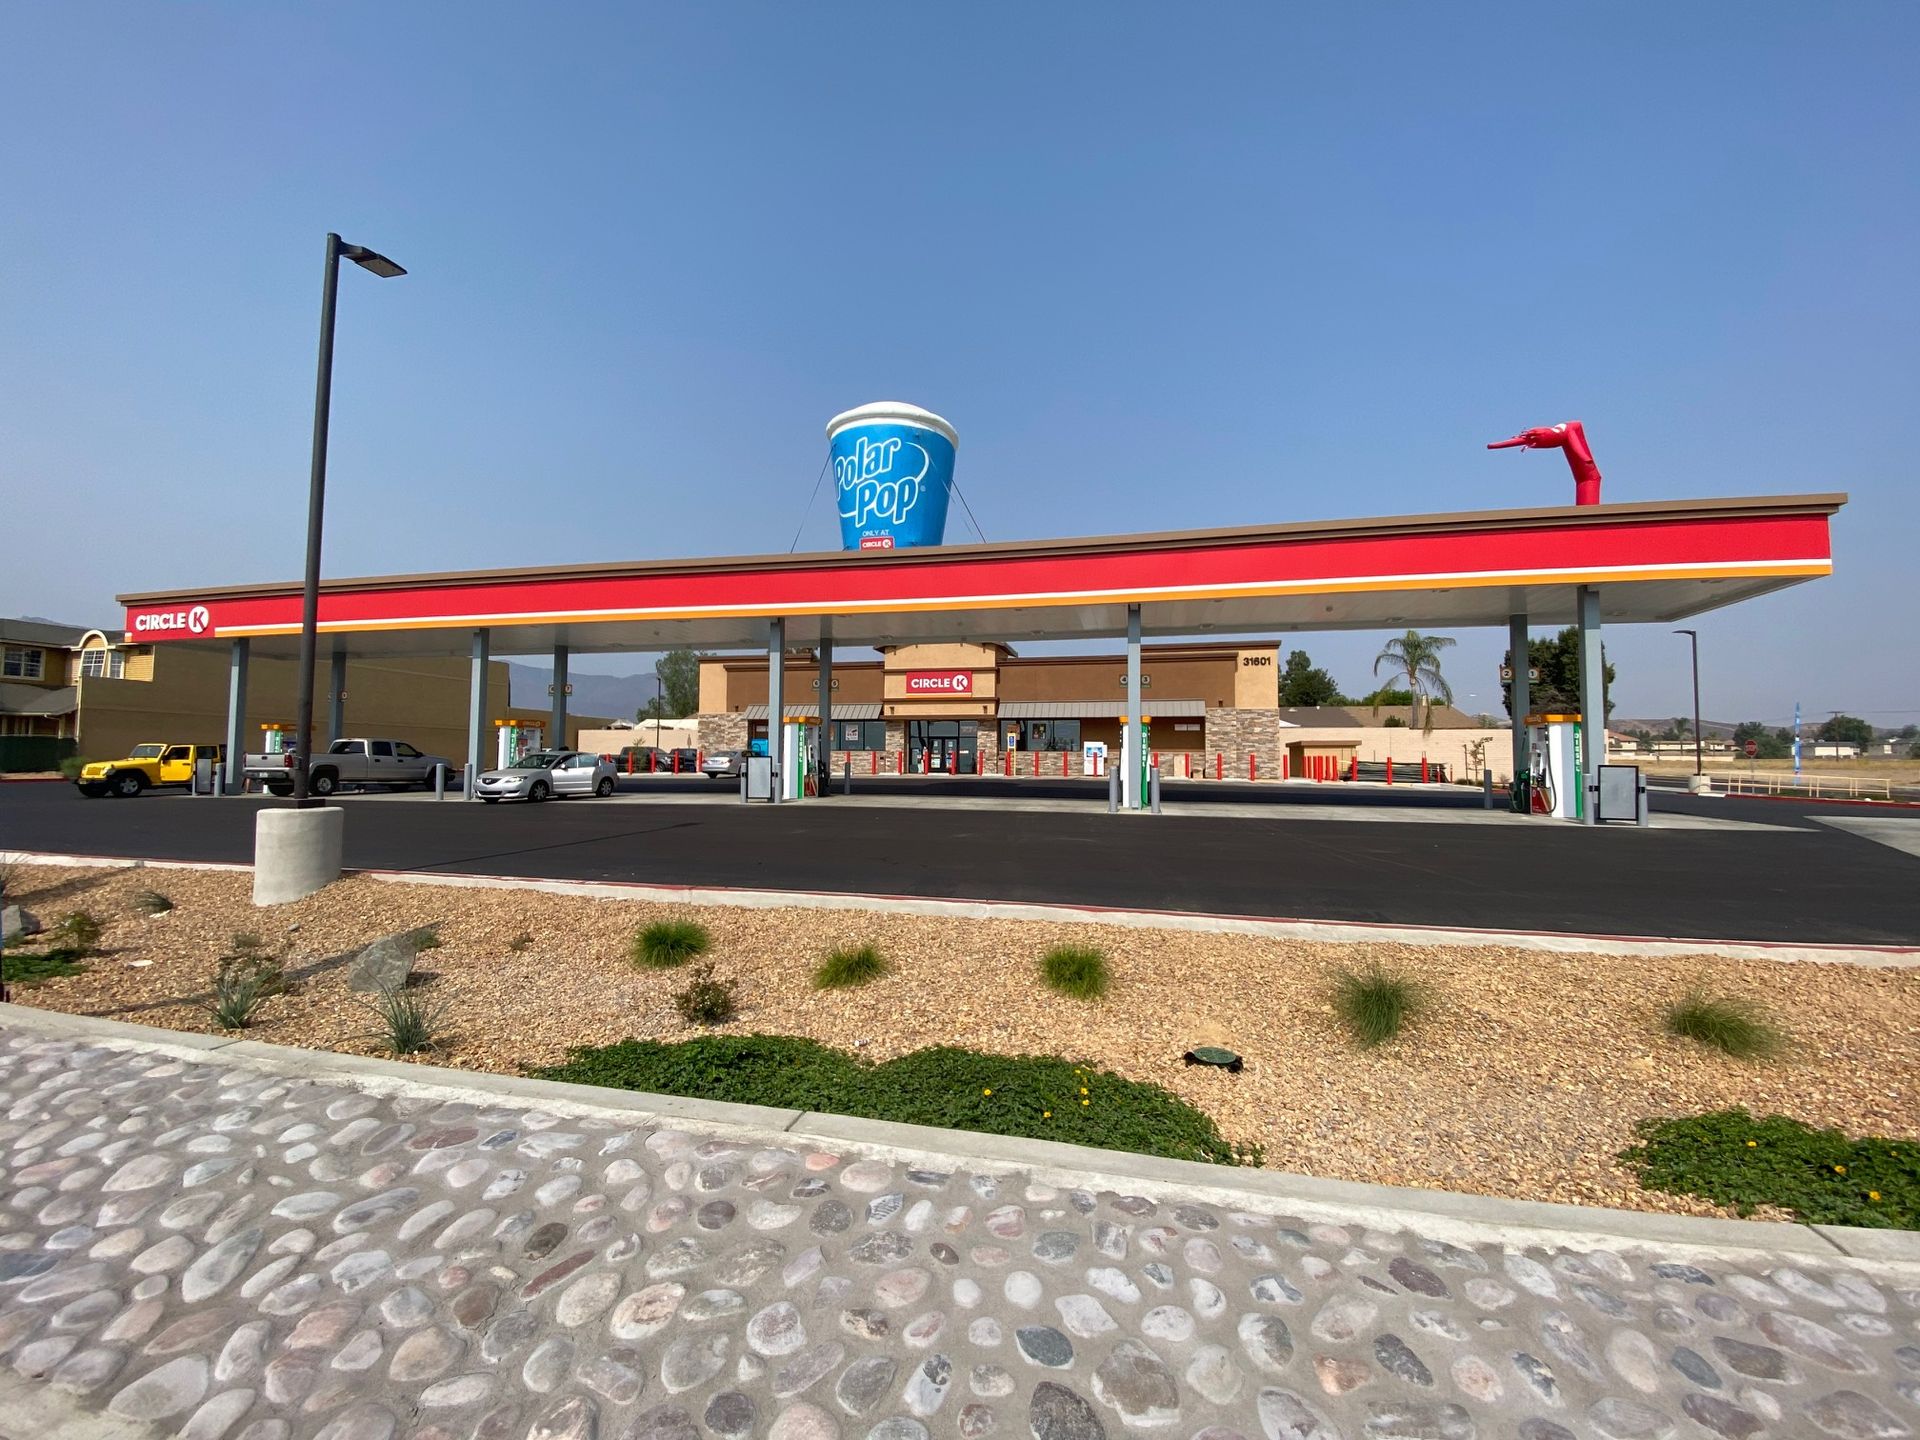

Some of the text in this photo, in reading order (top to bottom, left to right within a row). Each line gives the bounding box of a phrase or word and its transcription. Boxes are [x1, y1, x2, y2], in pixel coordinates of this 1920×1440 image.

[135, 607, 207, 632] CIRCLE K
[1243, 656, 1271, 667] 31601
[911, 676, 967, 690] CIRCLE K
